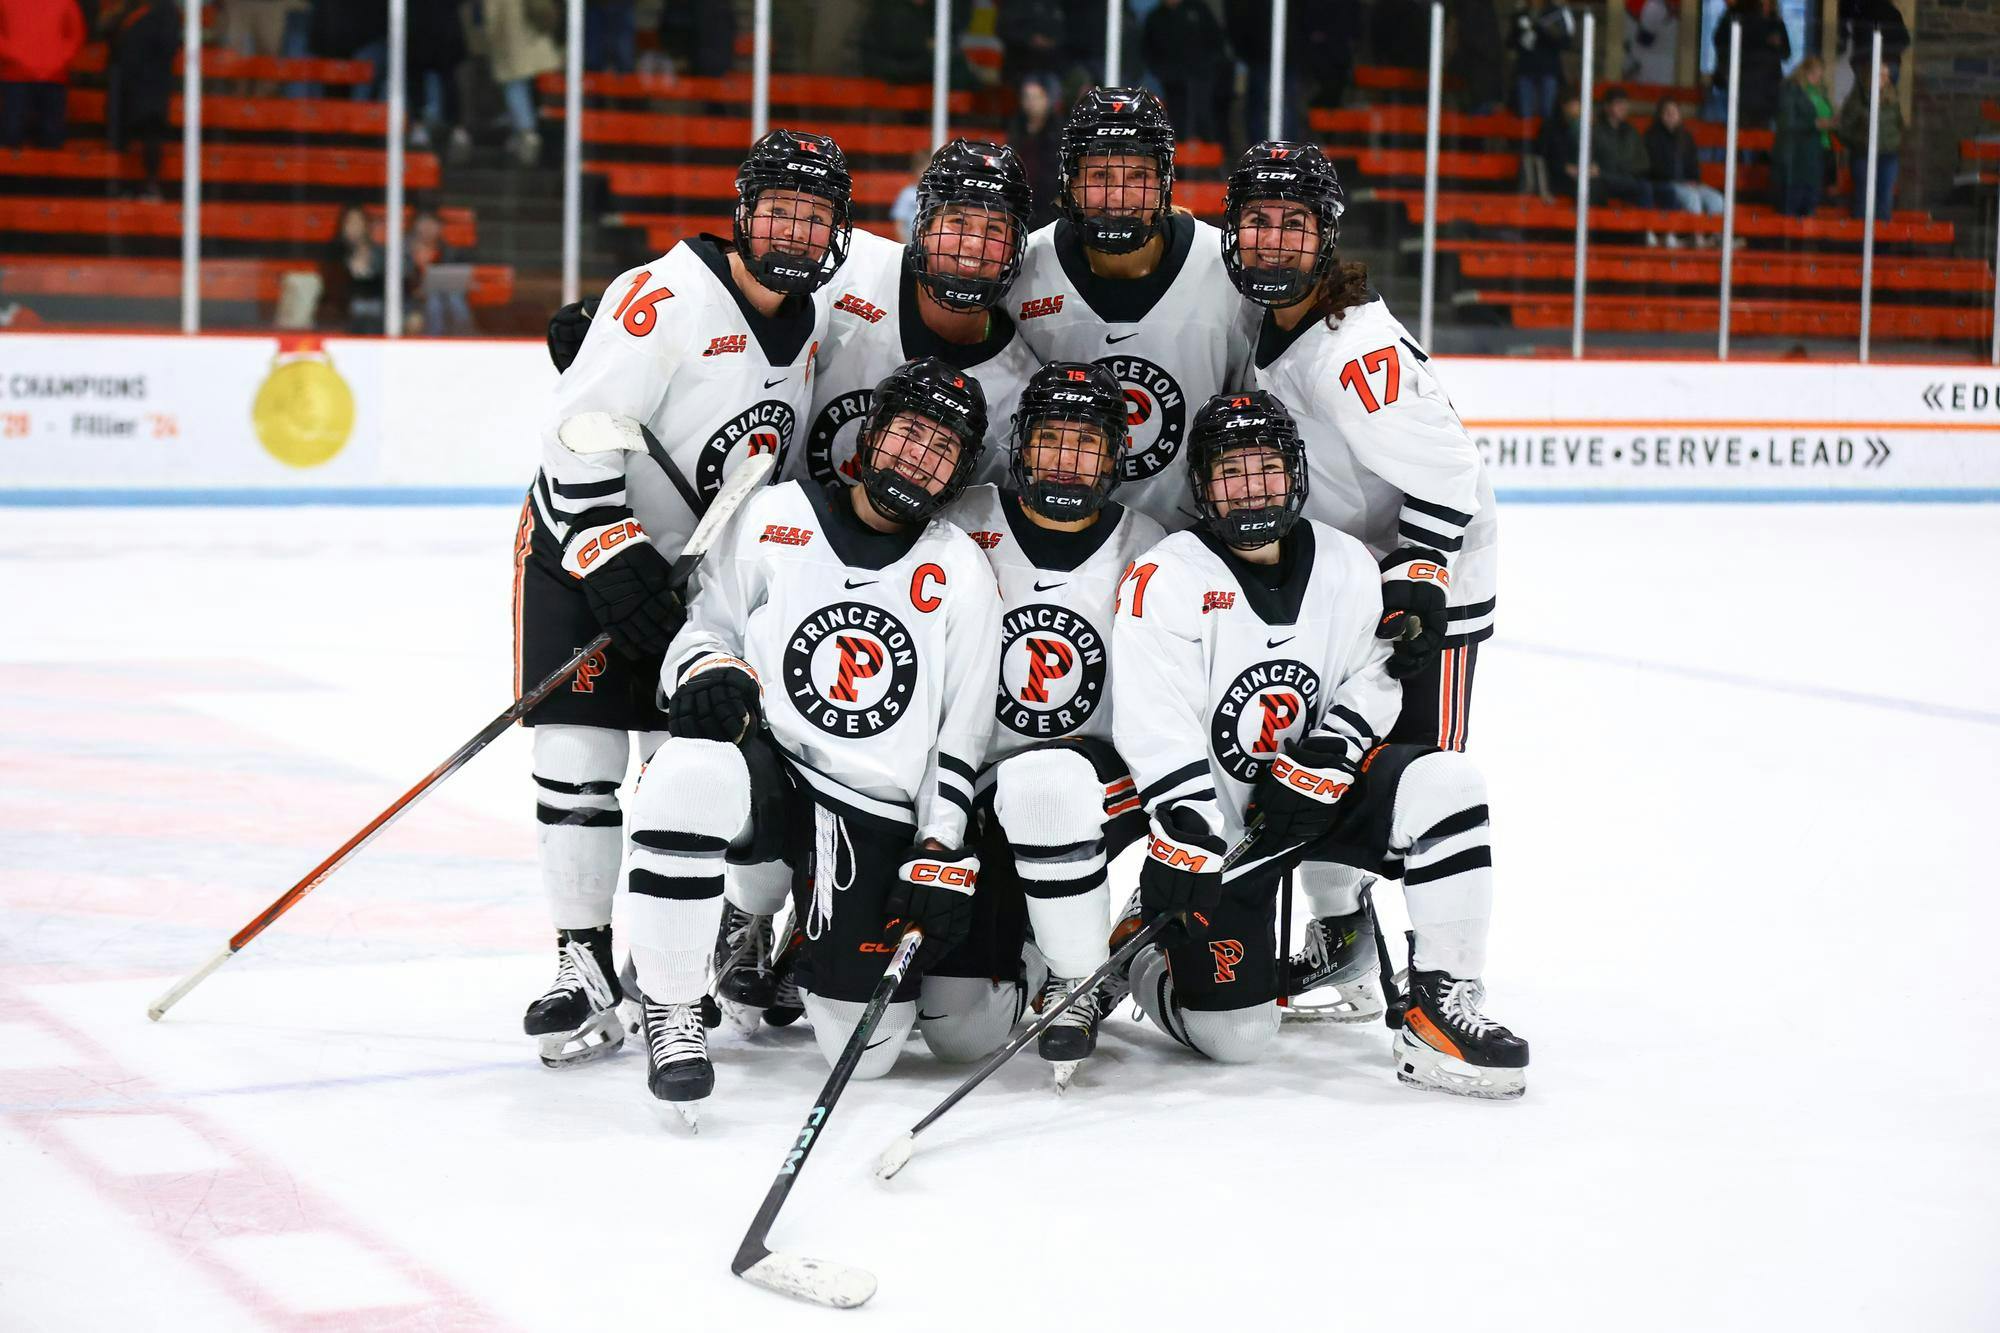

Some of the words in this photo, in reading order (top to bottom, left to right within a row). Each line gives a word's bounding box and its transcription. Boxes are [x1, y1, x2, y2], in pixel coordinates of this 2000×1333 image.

[1096, 128, 1137, 136] CCM
[1269, 149, 1289, 160] 17
[786, 162, 828, 176] CCM
[1256, 171, 1297, 181] CCM
[962, 178, 1003, 191] CCM
[1097, 231, 1133, 240] CCM
[773, 265, 810, 278] CCM
[945, 290, 982, 301] CCM
[1252, 283, 1288, 293] CCM
[612, 269, 675, 337] 16
[840, 293, 887, 319] ECAC
[1021, 294, 1065, 312] ECAC
[709, 334, 747, 350] ECAC
[953, 375, 965, 389] 3
[1066, 370, 1086, 382] 15
[1113, 360, 1181, 409] CETON
[1339, 345, 1401, 414] 17
[10, 374, 147, 399] CHAMPIONS
[932, 392, 970, 415] CCM
[1052, 392, 1094, 403] CCM
[1231, 397, 1252, 408] 21
[711, 404, 794, 454] PRINCETON
[1225, 418, 1267, 429] CCM
[887, 486, 921, 507] CCM
[1045, 495, 1082, 506] CCM
[764, 524, 813, 539] ECAC
[1240, 520, 1276, 531] CCM
[909, 562, 947, 613] C
[792, 606, 913, 667] PRINCETON
[1001, 608, 1102, 666] RINCETON
[829, 635, 884, 703] P
[1020, 637, 1074, 704] P
[1221, 664, 1320, 718] PRINCETON
[793, 681, 901, 733] TIGERS
[1252, 693, 1300, 754] P
[1270, 758, 1349, 799] CCM
[1208, 939, 1245, 983] P
[777, 1106, 826, 1176] CCM
